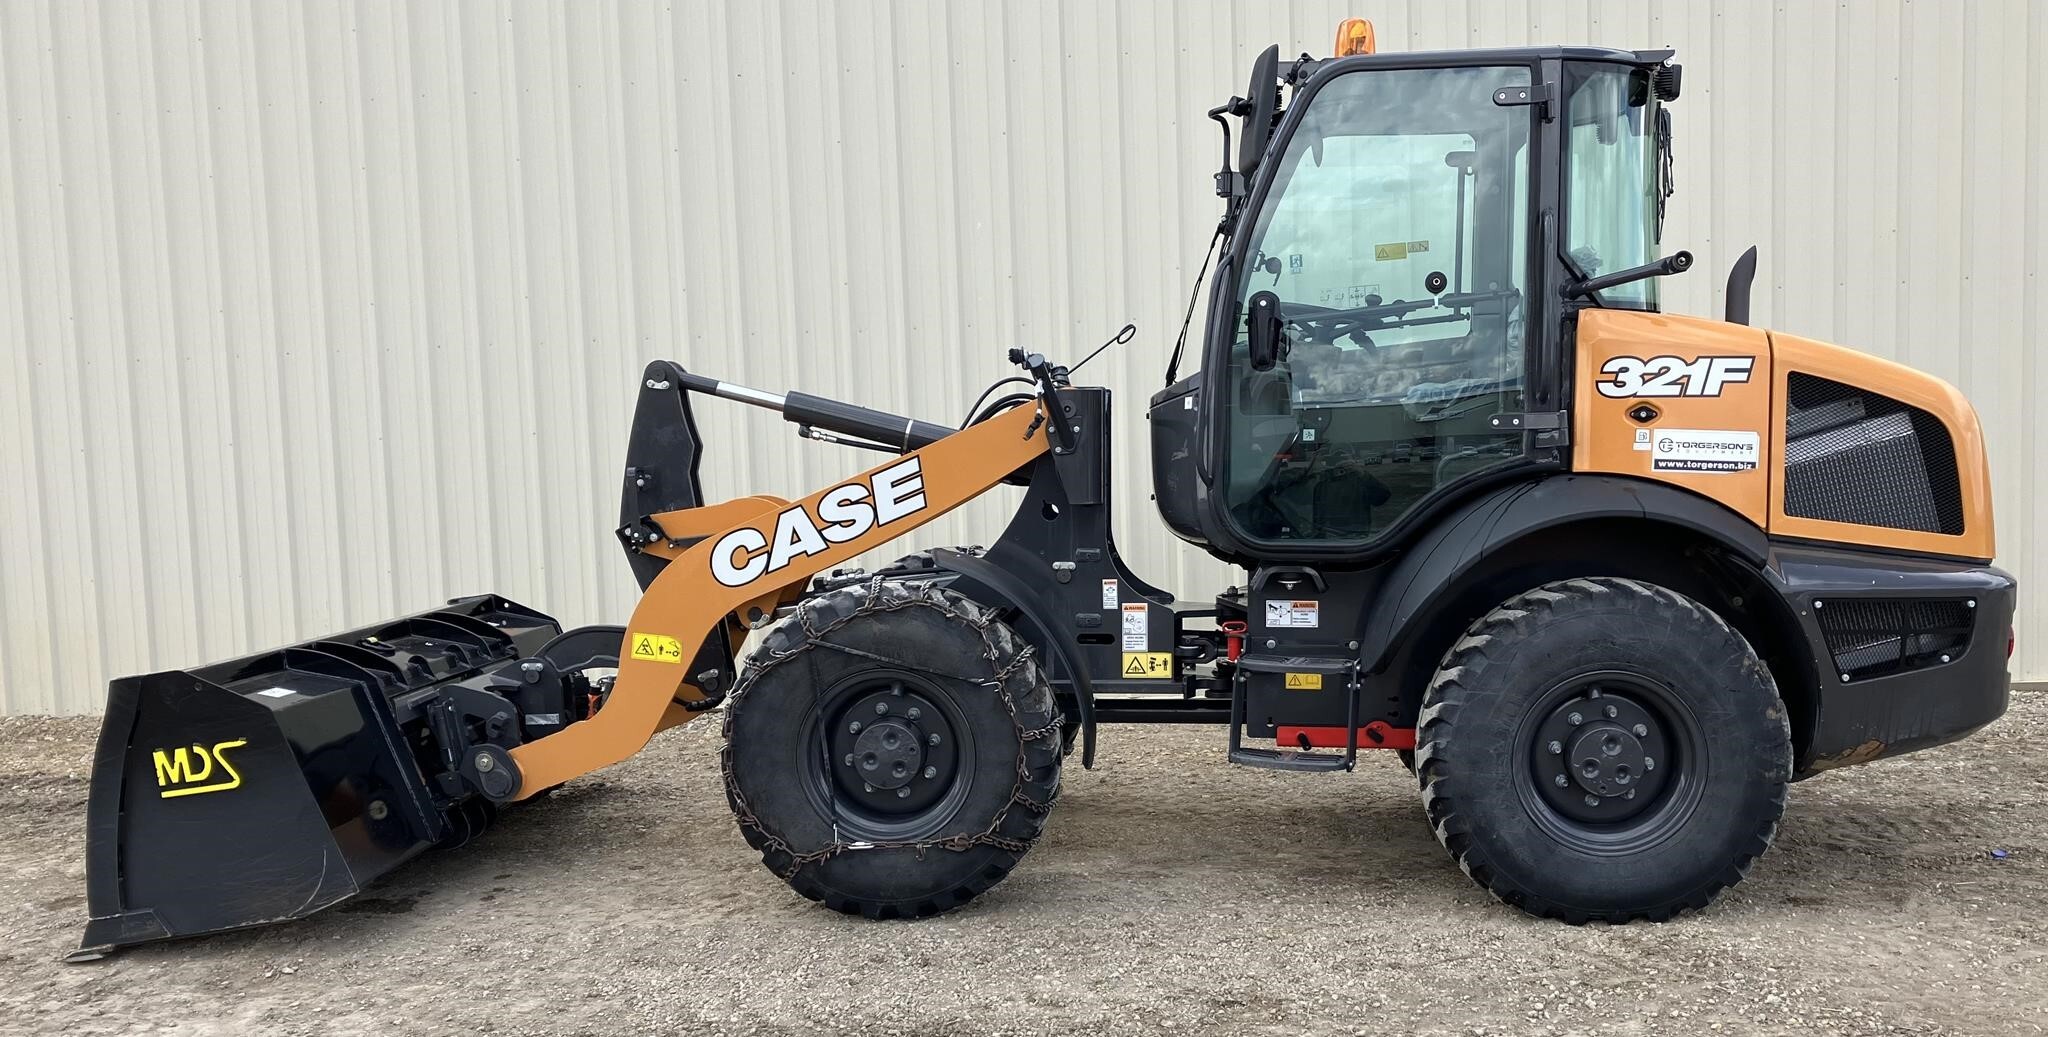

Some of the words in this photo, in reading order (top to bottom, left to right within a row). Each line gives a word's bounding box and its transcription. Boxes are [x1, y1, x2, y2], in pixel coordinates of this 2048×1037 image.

[1596, 355, 1756, 398] 321F
[1658, 460, 1752, 470] www.torgerson.biz
[1676, 442, 1753, 450] TORGERSON'S
[710, 455, 927, 587] CASE
[152, 739, 248, 798] MDS
